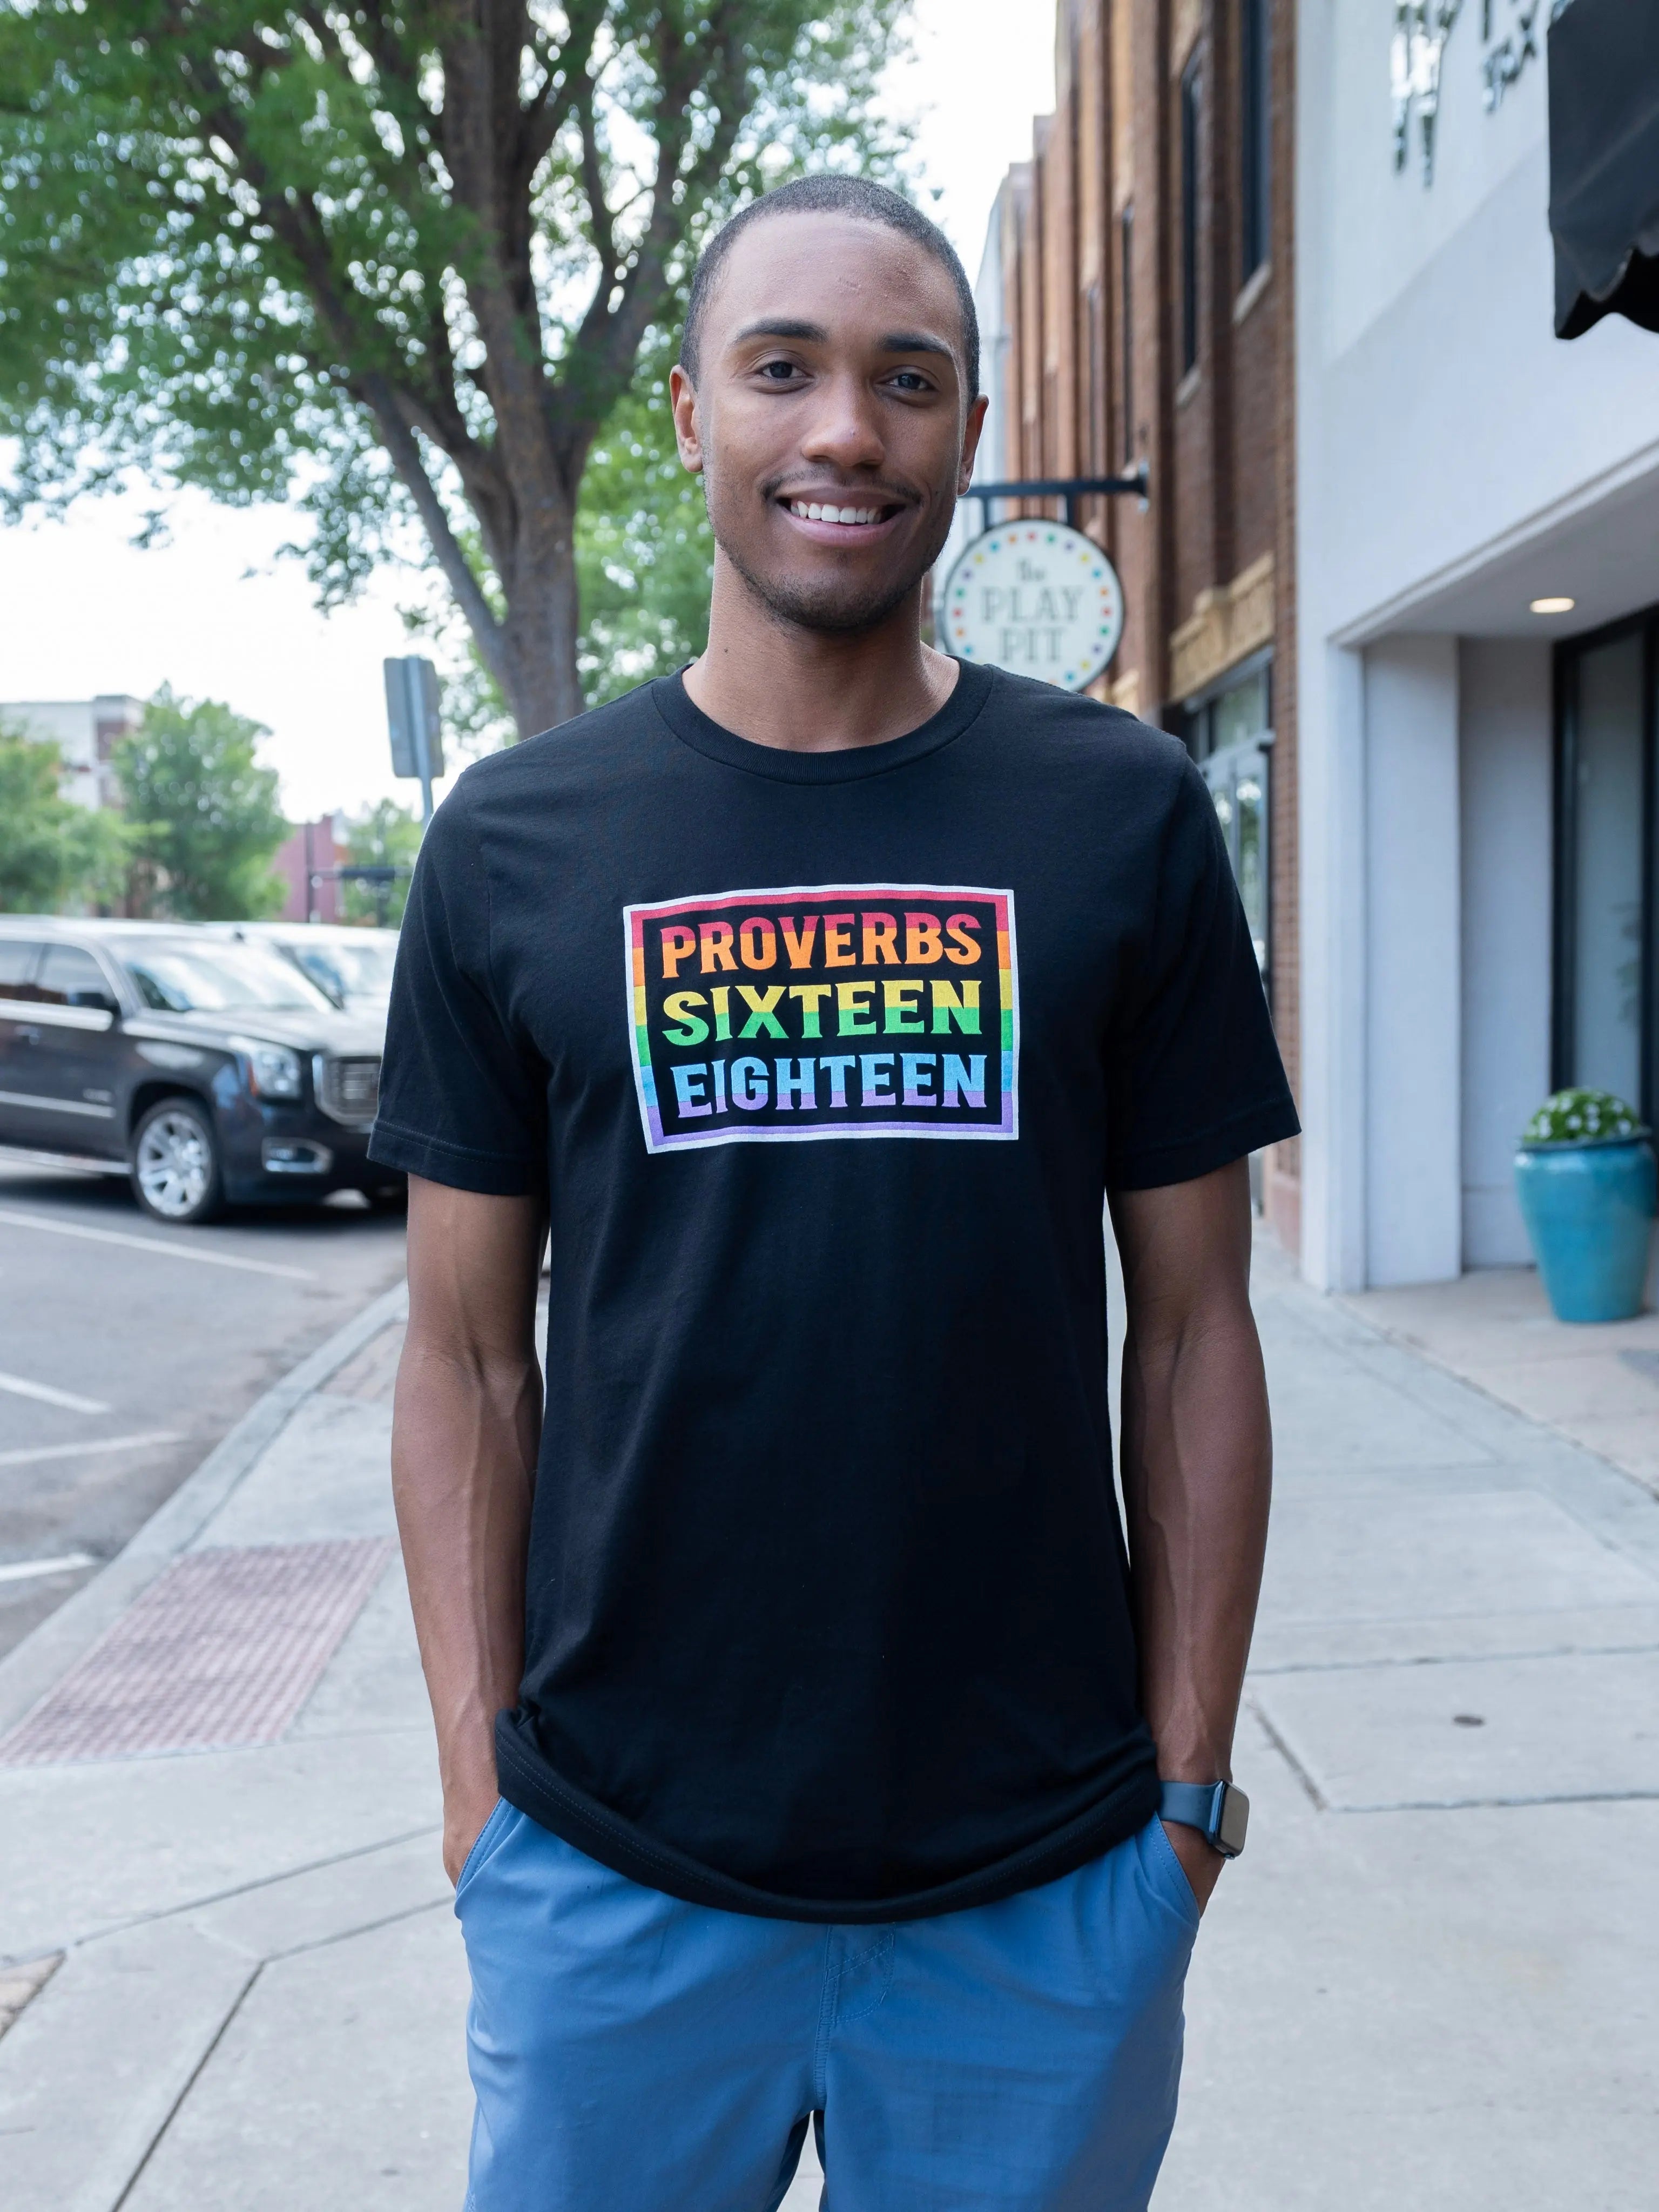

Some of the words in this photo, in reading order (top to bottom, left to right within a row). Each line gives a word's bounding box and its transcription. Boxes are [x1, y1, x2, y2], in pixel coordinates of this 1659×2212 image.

[982, 586, 1083, 622] PLAY
[1000, 628, 1064, 662] PIT
[659, 912, 982, 979] PROVERBS
[662, 980, 982, 1046] SIXTEEN
[670, 1053, 988, 1118] EIGHTEEN
